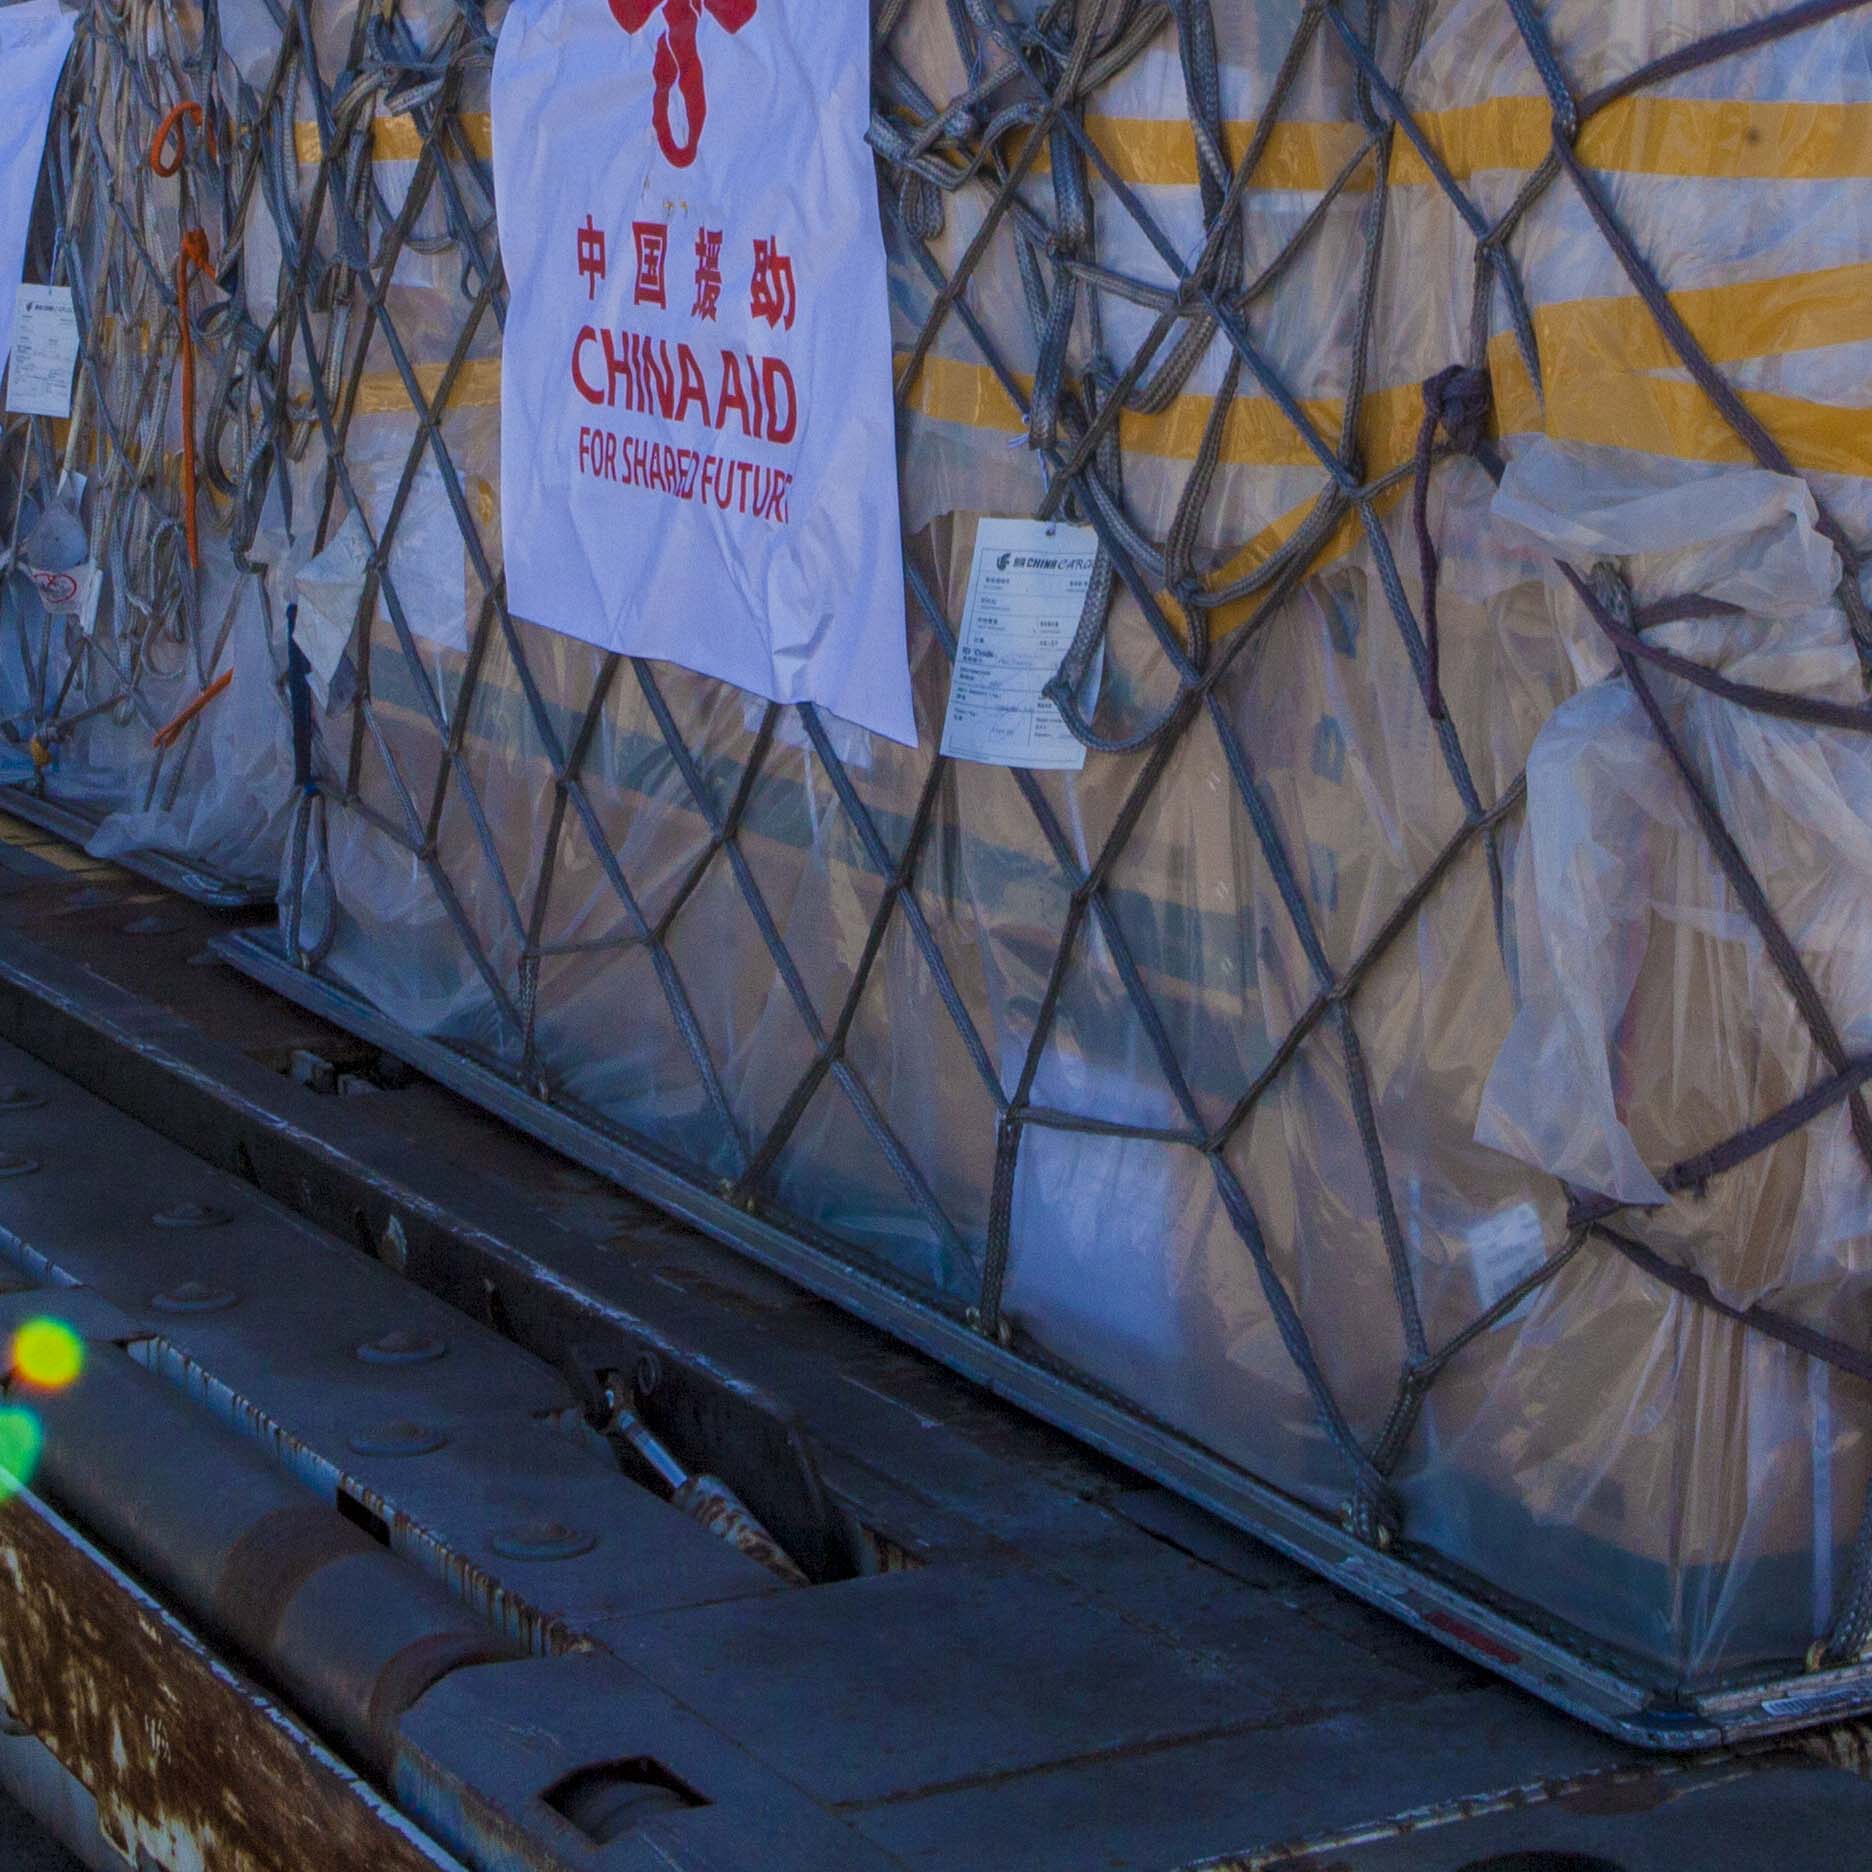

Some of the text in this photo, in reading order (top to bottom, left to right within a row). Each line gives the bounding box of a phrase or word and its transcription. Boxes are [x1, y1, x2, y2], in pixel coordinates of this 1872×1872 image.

[577, 214, 797, 332] 中国援助
[571, 325, 798, 444] CHINA AID
[578, 426, 617, 482] FOR
[1027, 558, 1057, 570] CHINA
[1058, 558, 1093, 570] CARG
